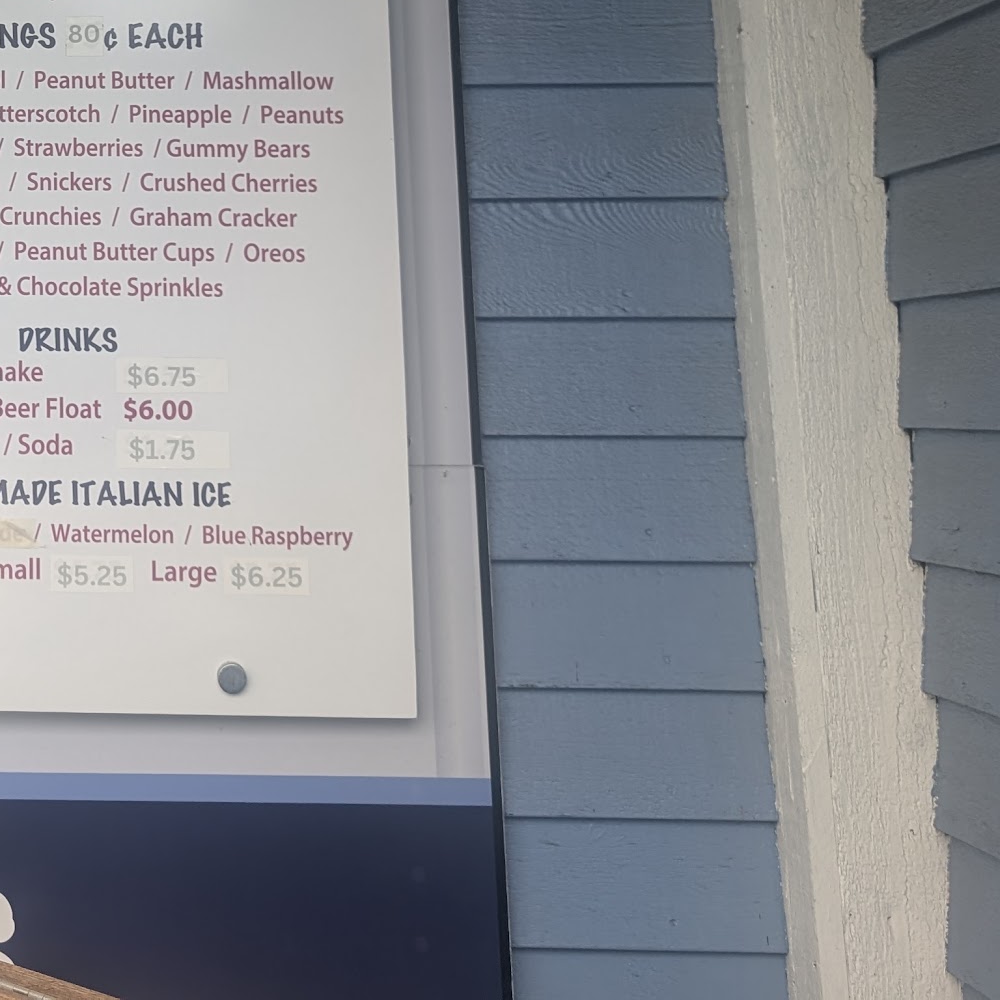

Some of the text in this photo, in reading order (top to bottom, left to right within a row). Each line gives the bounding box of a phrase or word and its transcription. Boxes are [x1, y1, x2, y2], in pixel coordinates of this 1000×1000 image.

[129, 23, 203, 49] EACH
[35, 71, 105, 89] Peanut
[112, 71, 175, 89] Butter
[204, 71, 333, 90] Mashmallow
[130, 105, 231, 128] Pineapple
[261, 106, 343, 124] Peanuts
[15, 138, 143, 157] Strawberries
[167, 139, 248, 163] Gummy
[255, 140, 310, 158] Bears
[0, 206, 101, 225] Crunchies
[130, 207, 212, 226] Graham
[219, 208, 297, 227] Cracker
[17, 276, 121, 296] Chocolate
[128, 277, 223, 301] Sprinkles
[19, 327, 117, 352] DRINKS
[128, 363, 195, 389] $6.75
[47, 397, 101, 418] Float
[124, 398, 192, 422] $6.00
[19, 433, 72, 455] Soda
[130, 436, 195, 462] $1.75
[72, 480, 183, 506] ITALIAN
[193, 482, 231, 507] ICE
[51, 524, 173, 543] Watermelon
[203, 525, 246, 544] Blue
[252, 526, 353, 551] Raspberry
[58, 562, 126, 588] $5.25
[152, 561, 216, 587] Large
[232, 563, 302, 590] $6.25
